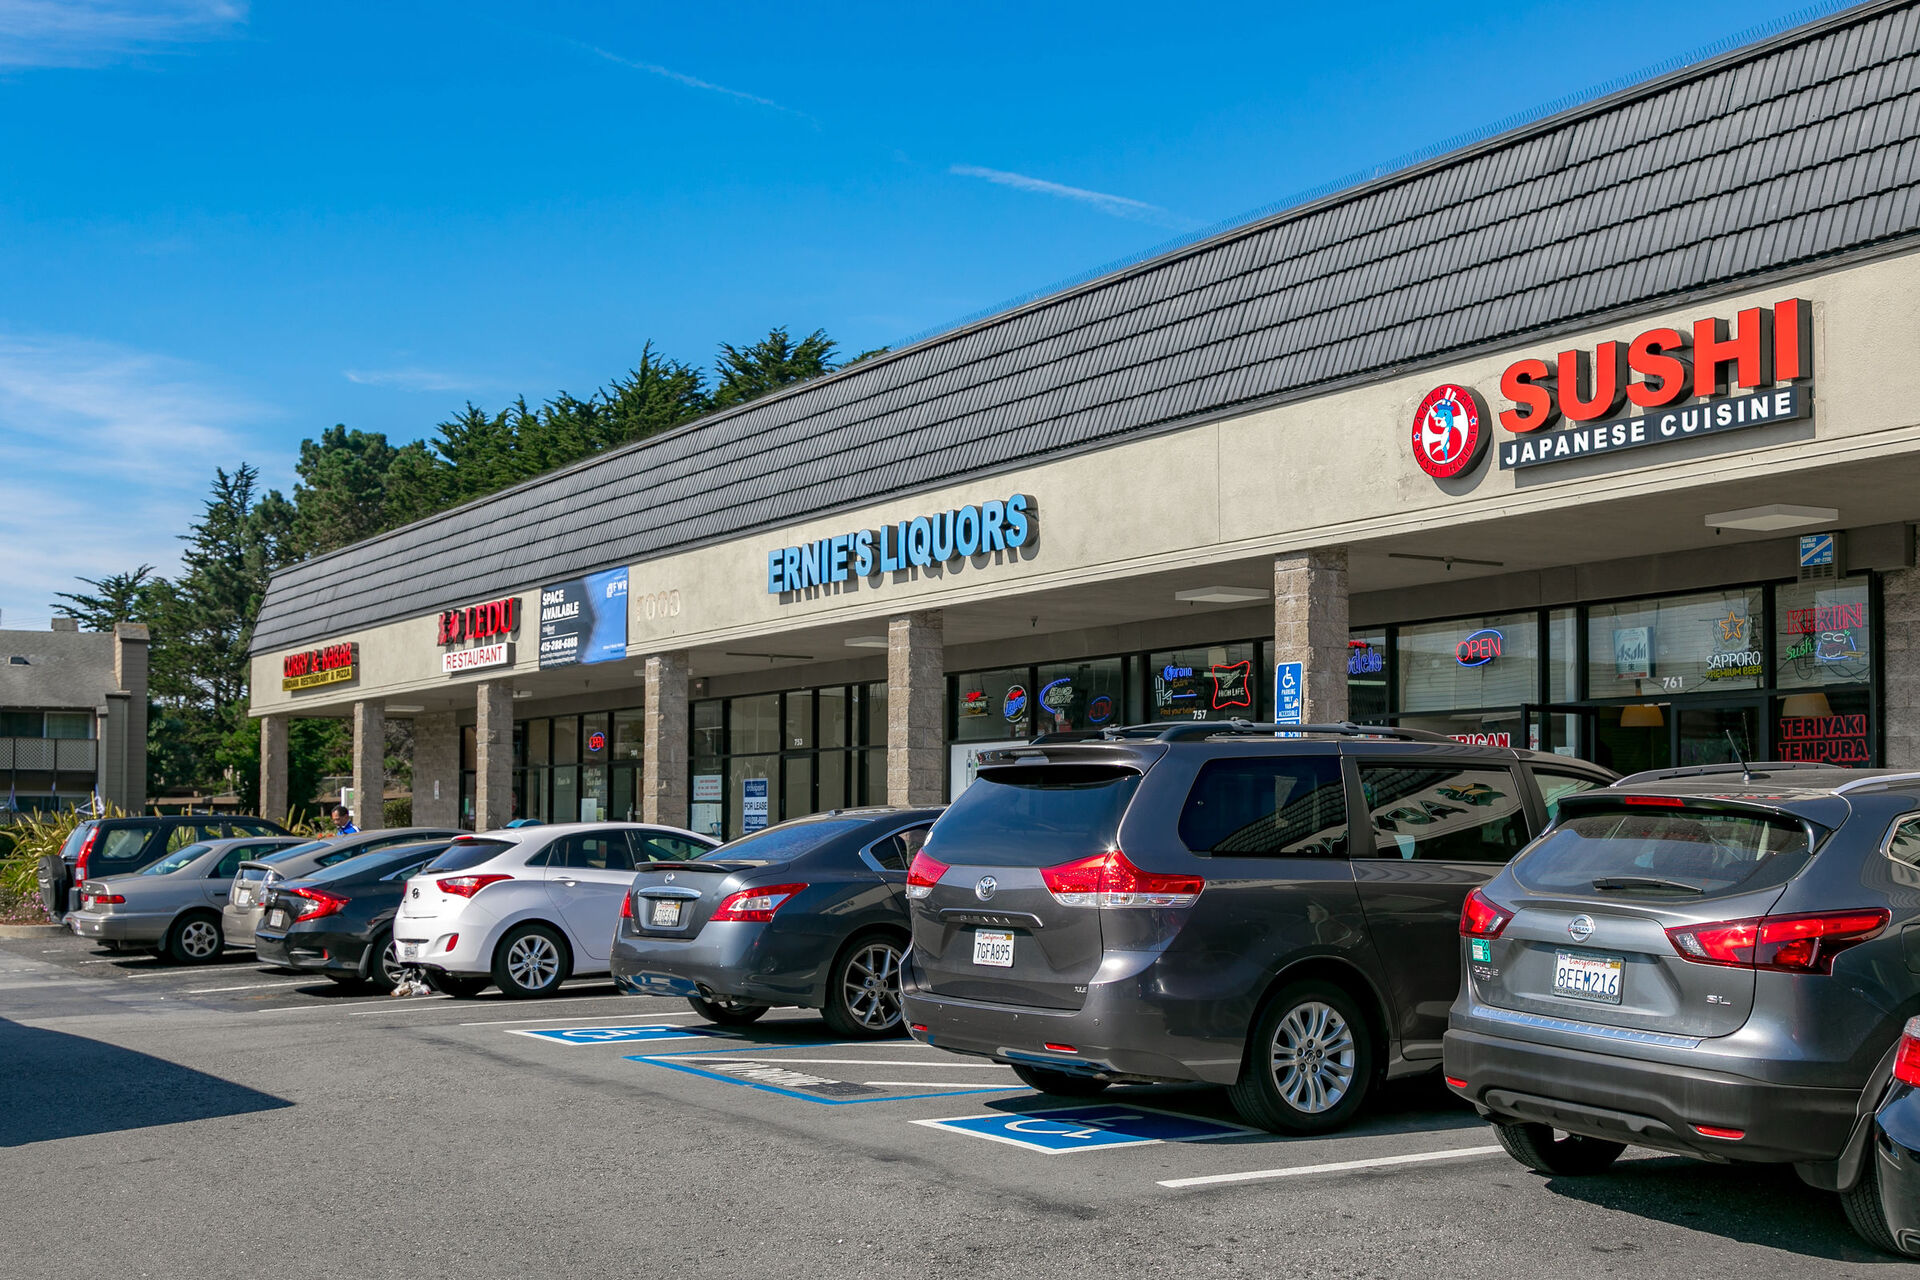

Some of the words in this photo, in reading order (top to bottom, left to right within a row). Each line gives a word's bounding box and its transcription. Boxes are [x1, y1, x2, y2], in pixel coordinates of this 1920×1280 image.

[1499, 298, 1800, 434] SUSHI
[1416, 387, 1474, 424] AMERCAN
[1505, 419, 1646, 466] JAPANESE
[1661, 393, 1792, 434] CUISINE
[1415, 444, 1443, 475] SUSHI
[1448, 431, 1477, 472] HOUSE
[768, 529, 874, 594] ERNIE'S
[881, 494, 1028, 571] LIQUORS
[542, 589, 564, 606] SPACE
[465, 598, 514, 640] LEDU
[542, 601, 579, 621] AVAILABLE
[1787, 603, 1863, 634] KIRIN
[446, 645, 503, 670] RESTAURANT
[1456, 637, 1501, 661] OPEN
[1616, 642, 1647, 661] Asahi
[284, 652, 309, 677] CURRY
[312, 650, 319, 672] &
[323, 642, 352, 670] KABAB
[1706, 651, 1761, 670] SAPPORO
[301, 673, 328, 686] RESTAURANT
[336, 667, 351, 680] PIZZA
[1163, 665, 1193, 682] Corona
[1705, 667, 1742, 679] PREMIUM
[1742, 665, 1763, 676] BEER
[1662, 676, 1683, 689] 761
[1218, 688, 1232, 698] HIGH
[1231, 687, 1245, 696] LIFE
[1088, 701, 1113, 719] ATM
[1192, 709, 1208, 720] 757
[1780, 714, 1867, 741] TERIYAKI
[1778, 739, 1870, 763] TEMPURA
[744, 801, 753, 811] FOR
[753, 801, 767, 811] LEASE
[977, 942, 1010, 961] 7GFA895
[1568, 957, 1607, 969] California
[1557, 967, 1618, 996] 8EEM216
[1706, 994, 1731, 1006] SL
